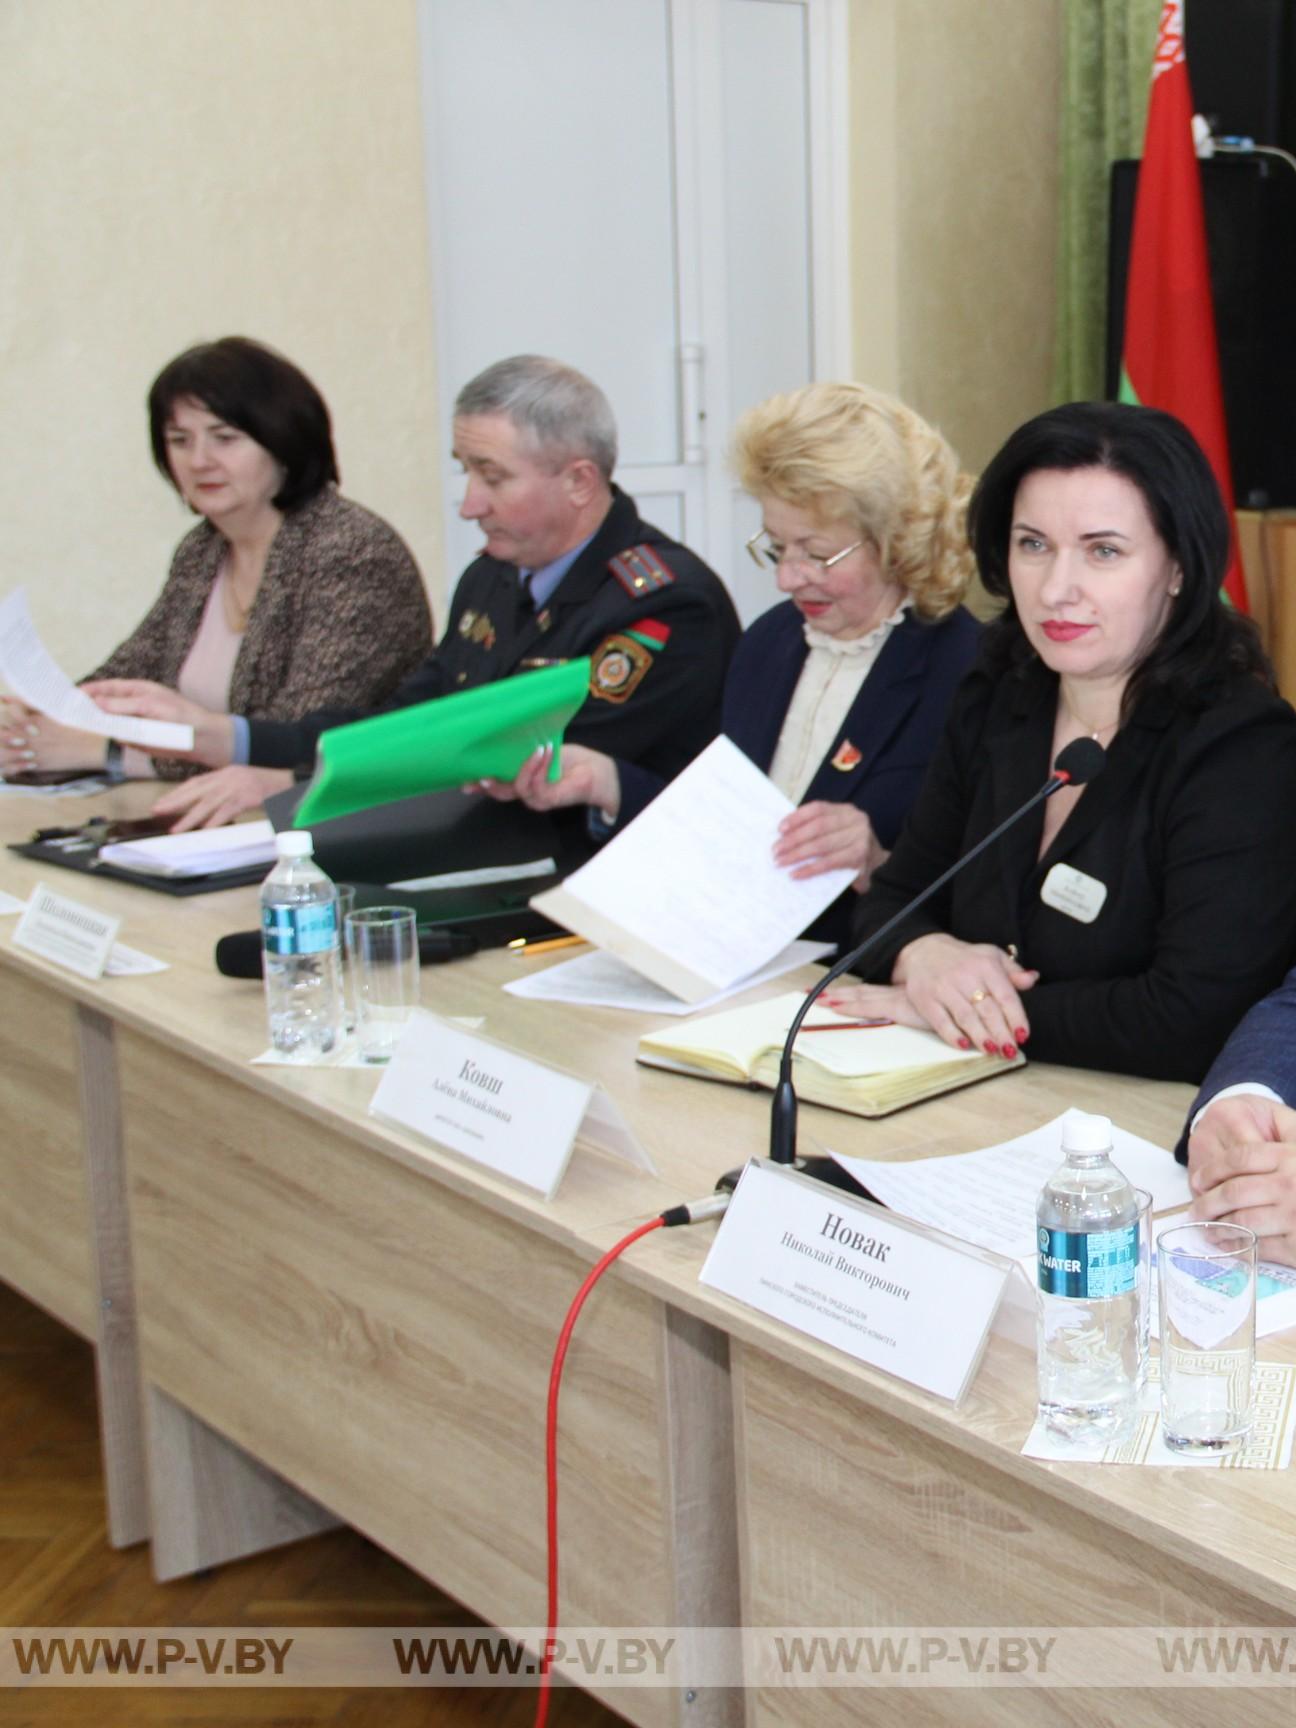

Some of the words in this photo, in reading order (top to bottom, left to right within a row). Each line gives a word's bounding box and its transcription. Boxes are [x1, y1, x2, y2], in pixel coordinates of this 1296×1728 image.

[459, 1059, 503, 1094] Ковш
[820, 1212, 891, 1263] Новак
[780, 1231, 834, 1267] Николай
[834, 1256, 911, 1301] Викторович
